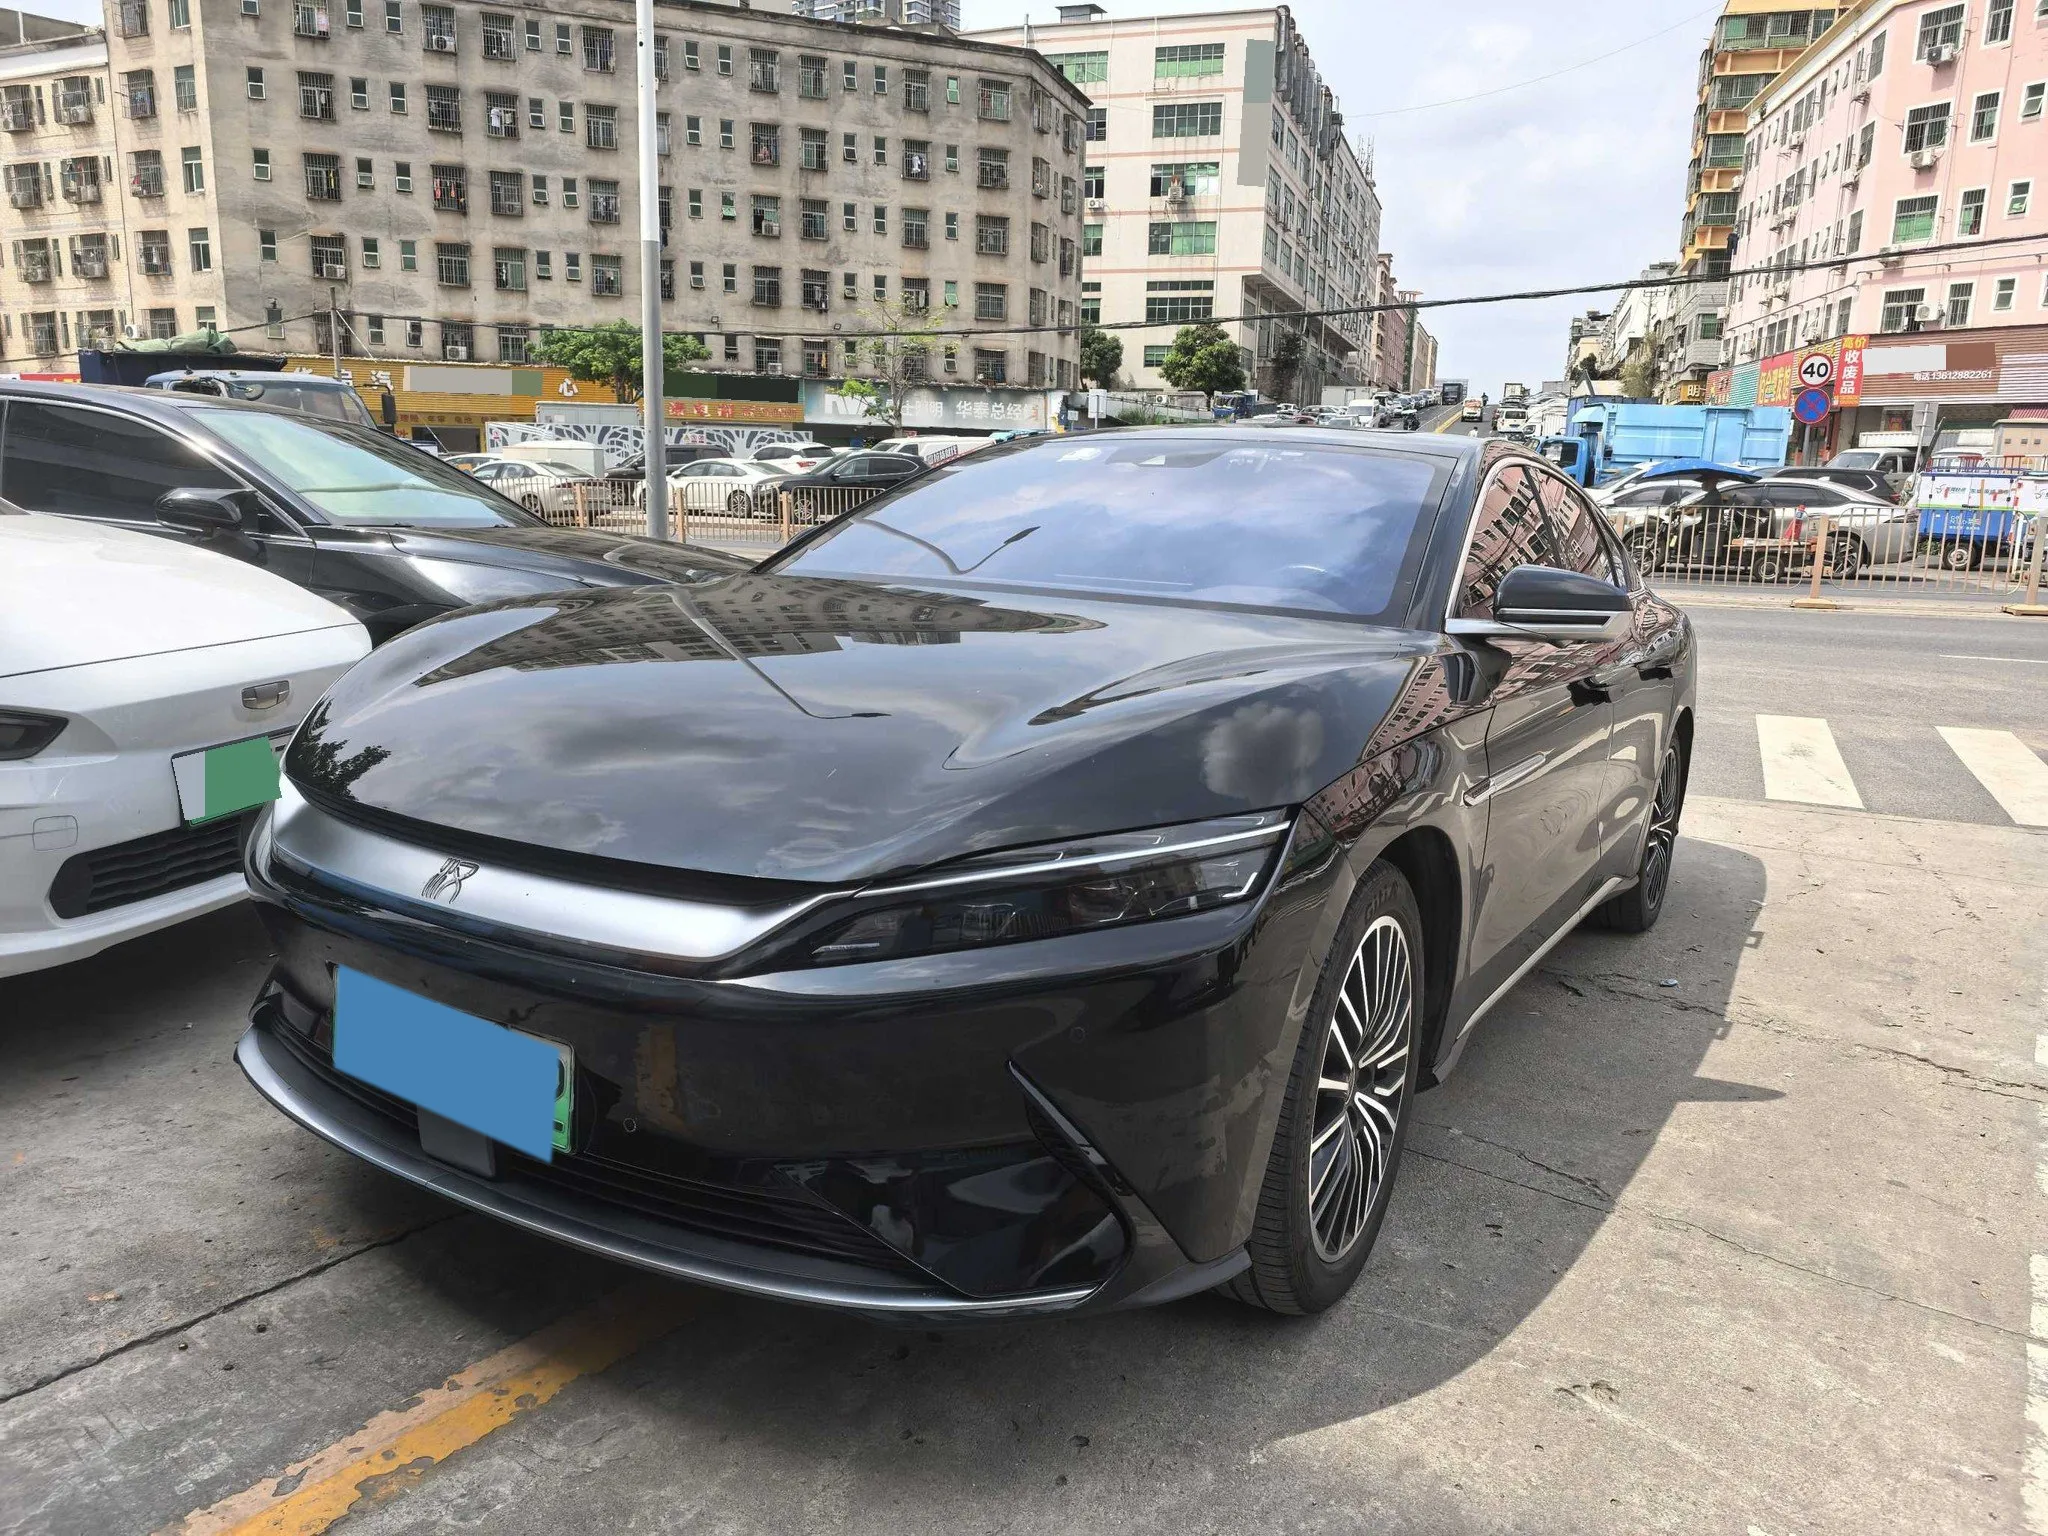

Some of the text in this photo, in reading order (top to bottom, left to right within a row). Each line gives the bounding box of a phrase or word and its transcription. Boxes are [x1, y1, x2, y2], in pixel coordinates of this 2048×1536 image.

[1844, 337, 1867, 349] 高价
[1803, 363, 1829, 378] 40
[1840, 350, 1861, 394] 收废品
[1913, 370, 1993, 381] 电话 13612882261
